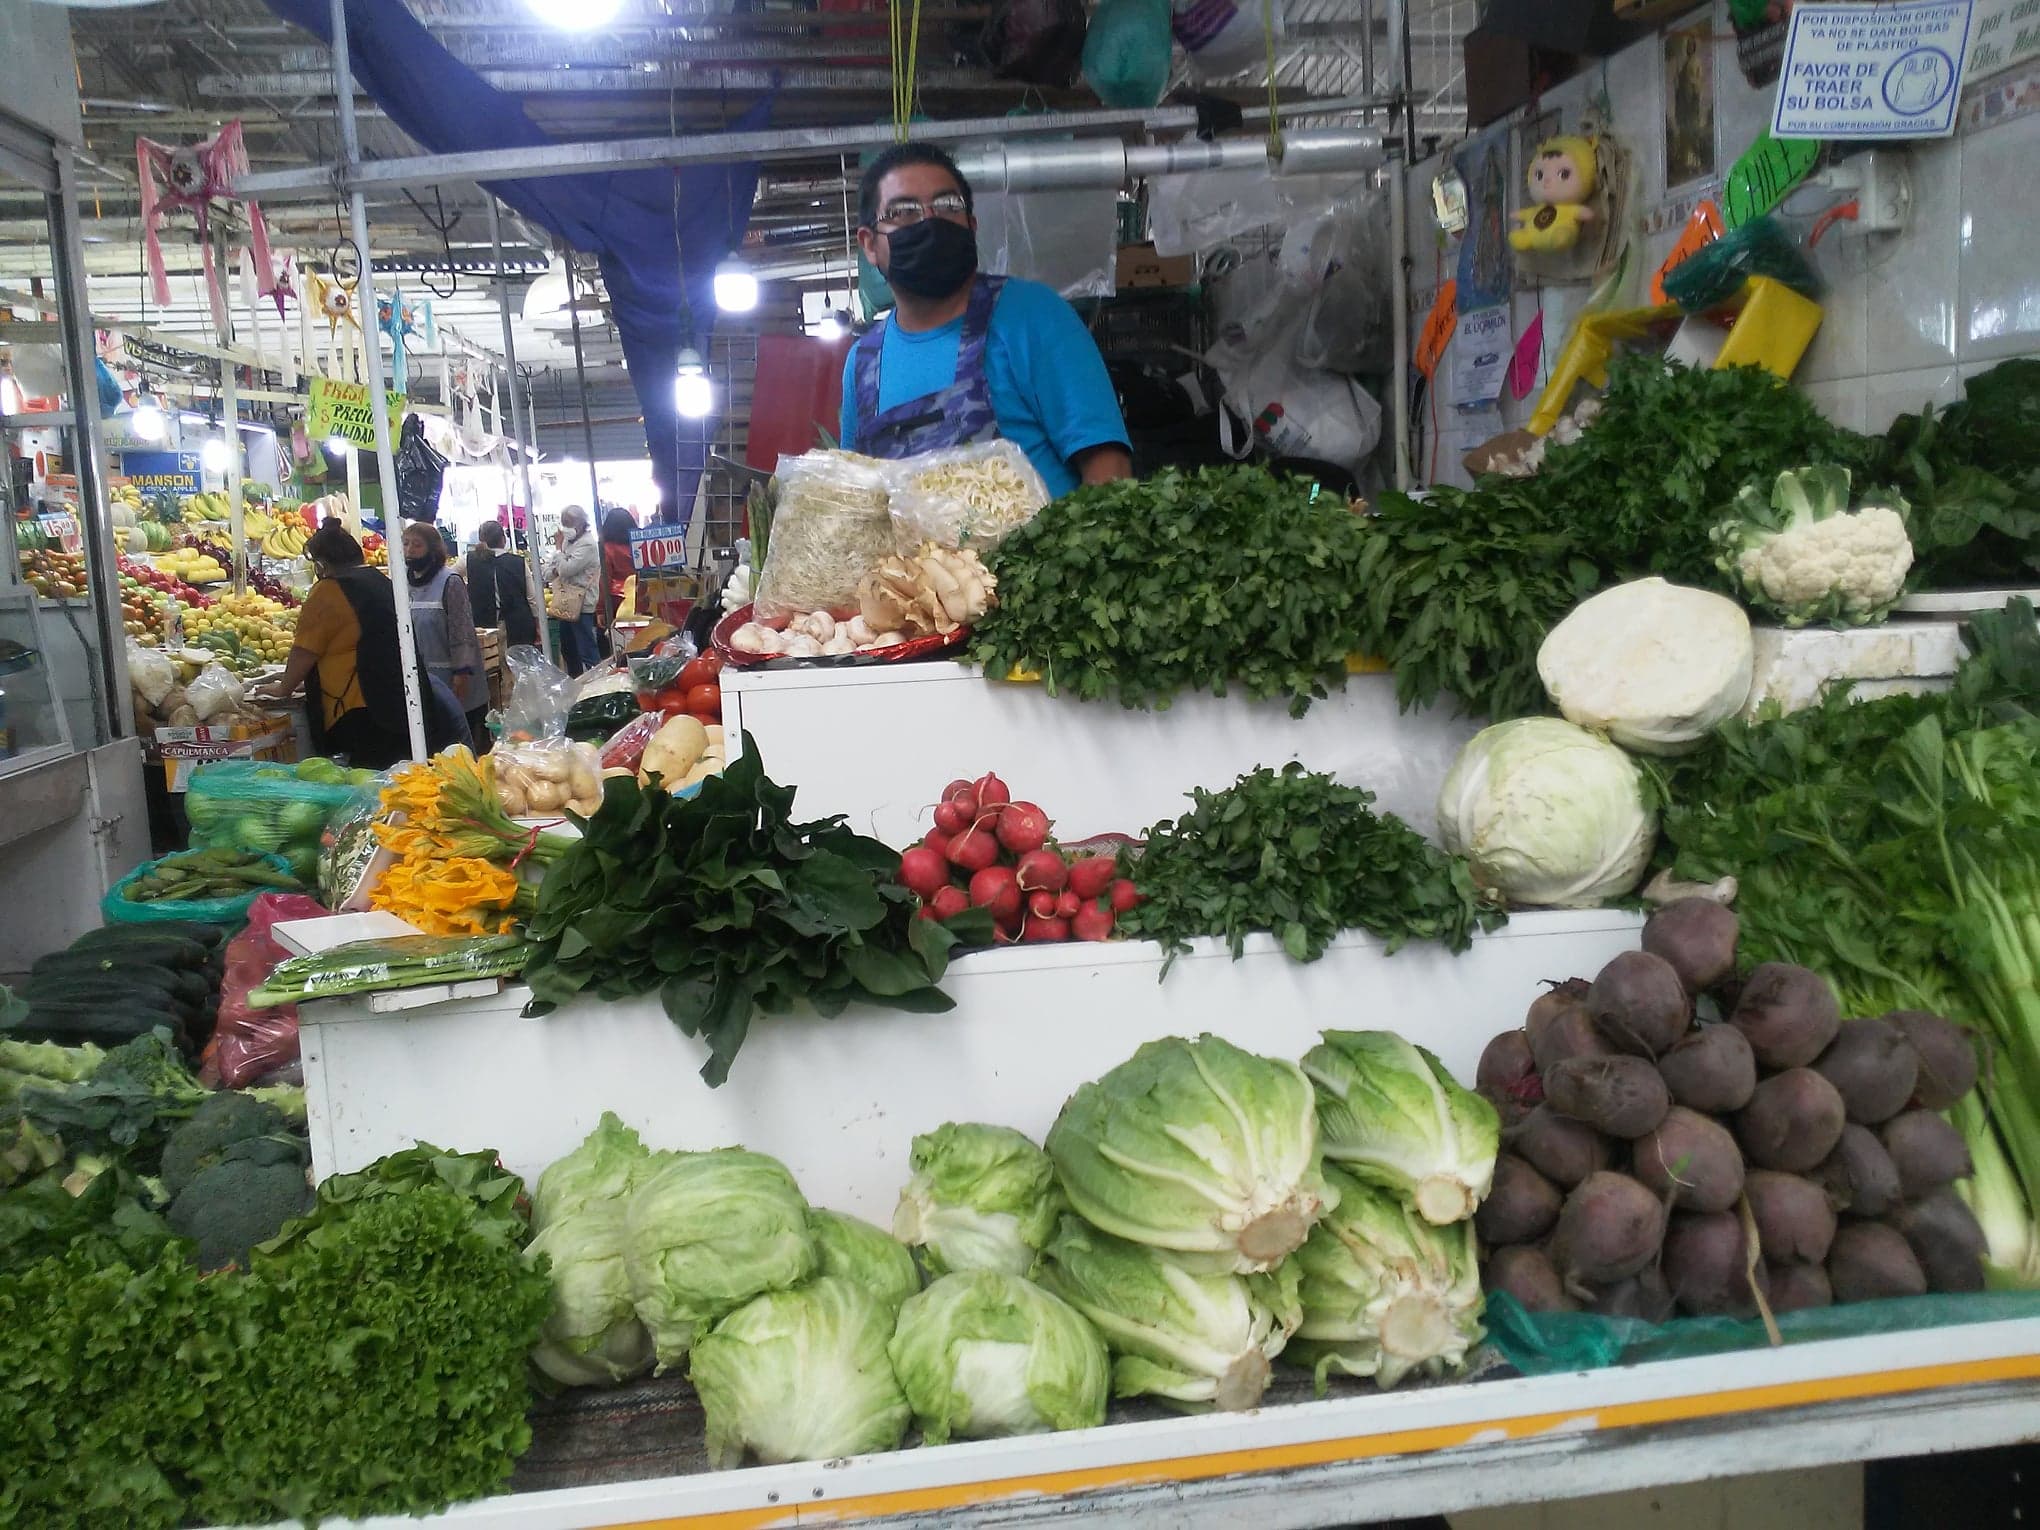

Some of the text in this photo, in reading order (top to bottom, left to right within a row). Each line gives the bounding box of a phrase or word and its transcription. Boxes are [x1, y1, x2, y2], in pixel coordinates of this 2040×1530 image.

[1802, 15, 1828, 25] POR
[1915, 7, 1960, 21] OFICIAL
[1811, 23, 1949, 39] YA NO SE DAN BOLSAS
[1837, 40, 1853, 51] DE
[1793, 62, 1879, 77] FAVOR DE
[1806, 80, 1862, 93] TRAER
[1787, 95, 1872, 110] SU BOLSA
[1788, 121, 1807, 130] POR
[330, 421, 375, 444] CALIDAD
[131, 474, 195, 487] MANSON
